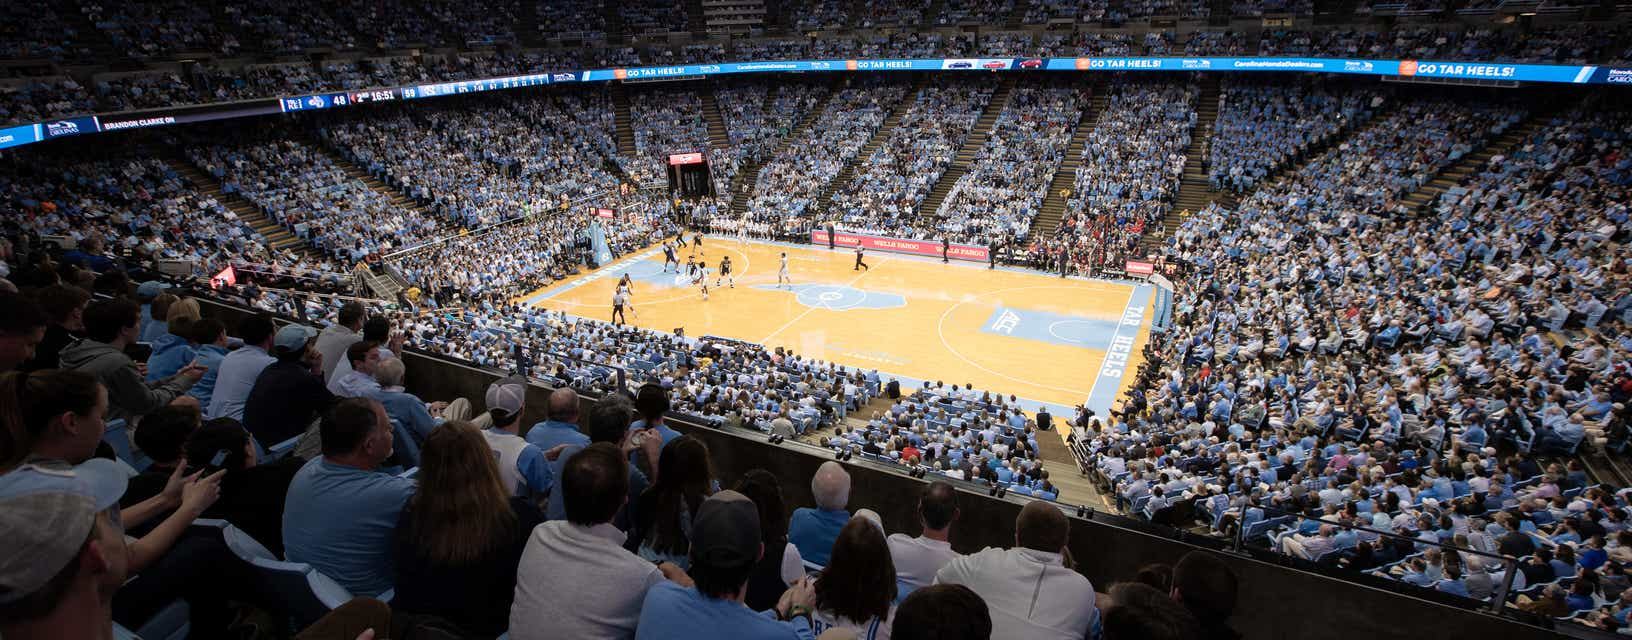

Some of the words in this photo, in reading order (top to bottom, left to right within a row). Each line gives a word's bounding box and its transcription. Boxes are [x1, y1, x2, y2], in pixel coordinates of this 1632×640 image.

[1127, 60, 1162, 68] HEELS!
[1234, 60, 1324, 68] CarolinaHondaDealers.com
[657, 67, 685, 75] HEELS!
[1417, 64, 1437, 73] GO
[1439, 64, 1463, 75] TAR
[1466, 65, 1515, 77] HEELS!
[371, 90, 394, 102] 16:51
[404, 89, 415, 98] 59
[333, 95, 346, 106] 48
[104, 119, 138, 130] BRANDON
[139, 117, 164, 127] CLARKE
[165, 116, 175, 124] ON
[874, 239, 896, 248] WELLS
[897, 241, 919, 250] FARGO
[960, 247, 985, 257] FARGO
[991, 308, 1021, 334] ACC
[1122, 305, 1145, 327] TAR
[1102, 335, 1134, 379] HEELS
